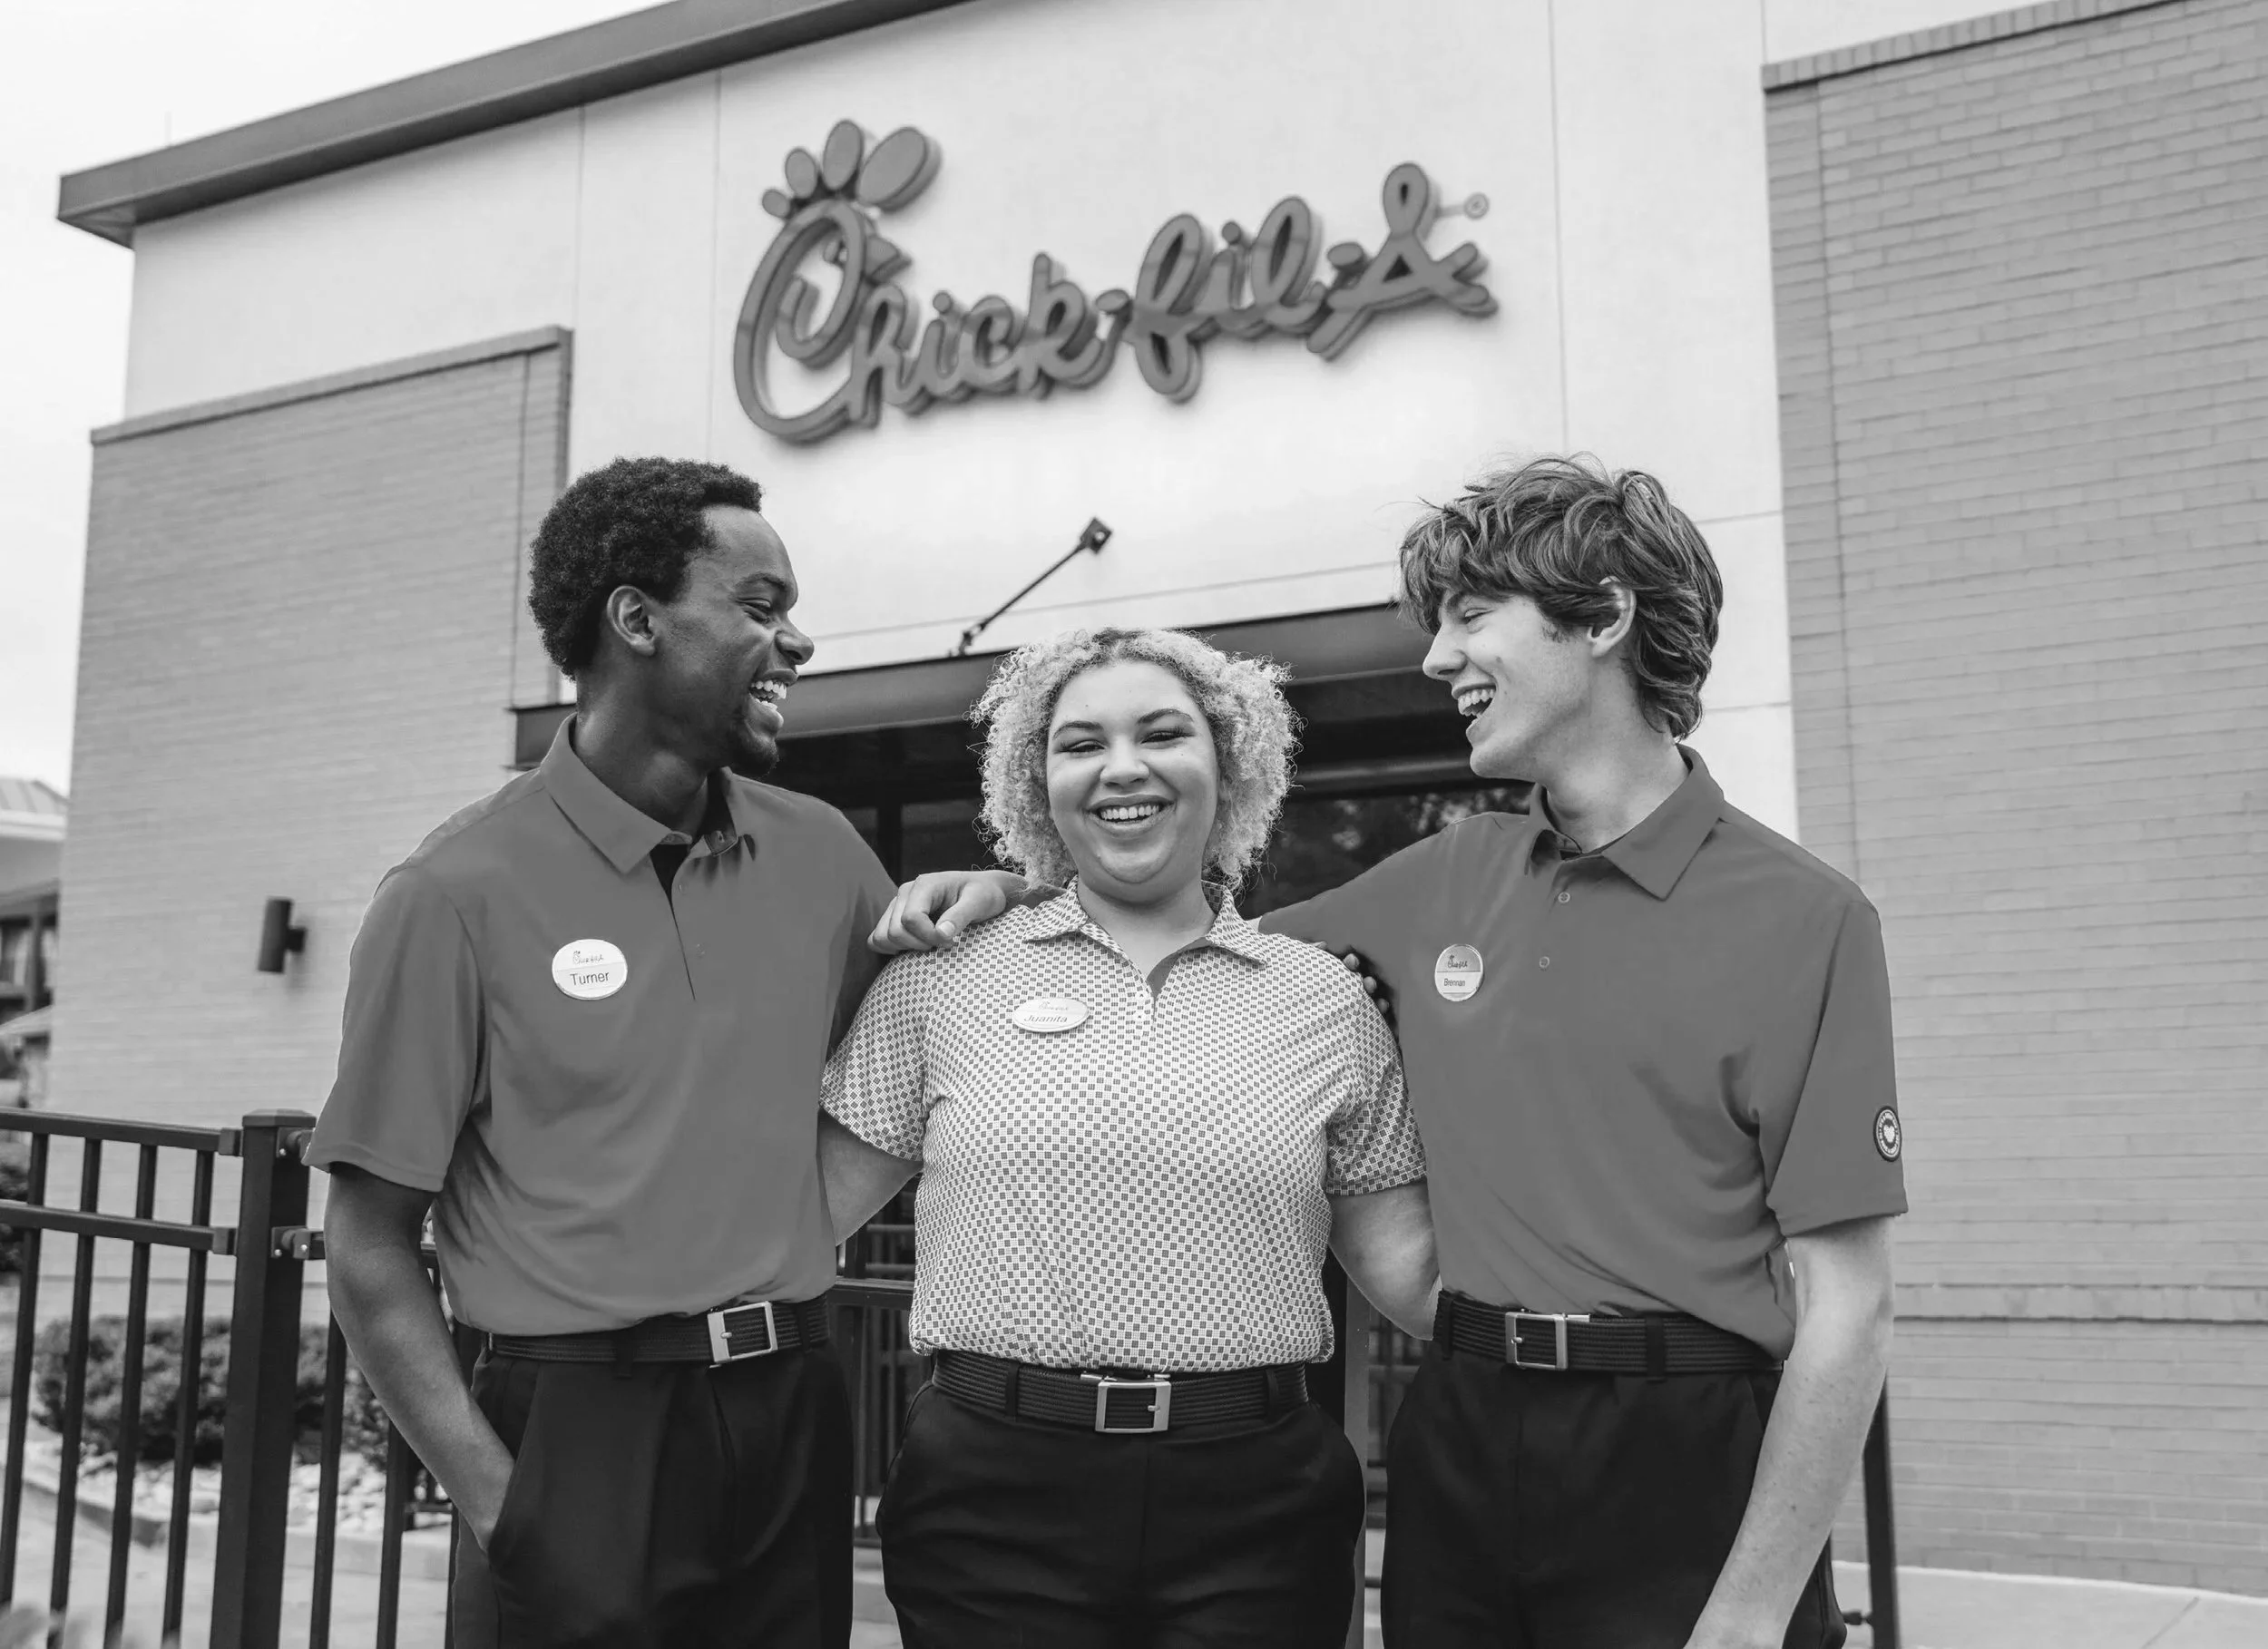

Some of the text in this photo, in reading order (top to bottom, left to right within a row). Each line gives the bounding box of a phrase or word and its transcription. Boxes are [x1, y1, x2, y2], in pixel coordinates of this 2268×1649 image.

[733, 119, 1499, 443] Chick-fil-A
[569, 971, 610, 986] Turner
[1443, 978, 1466, 987] Brennan
[1023, 1015, 1068, 1023] Juanita
